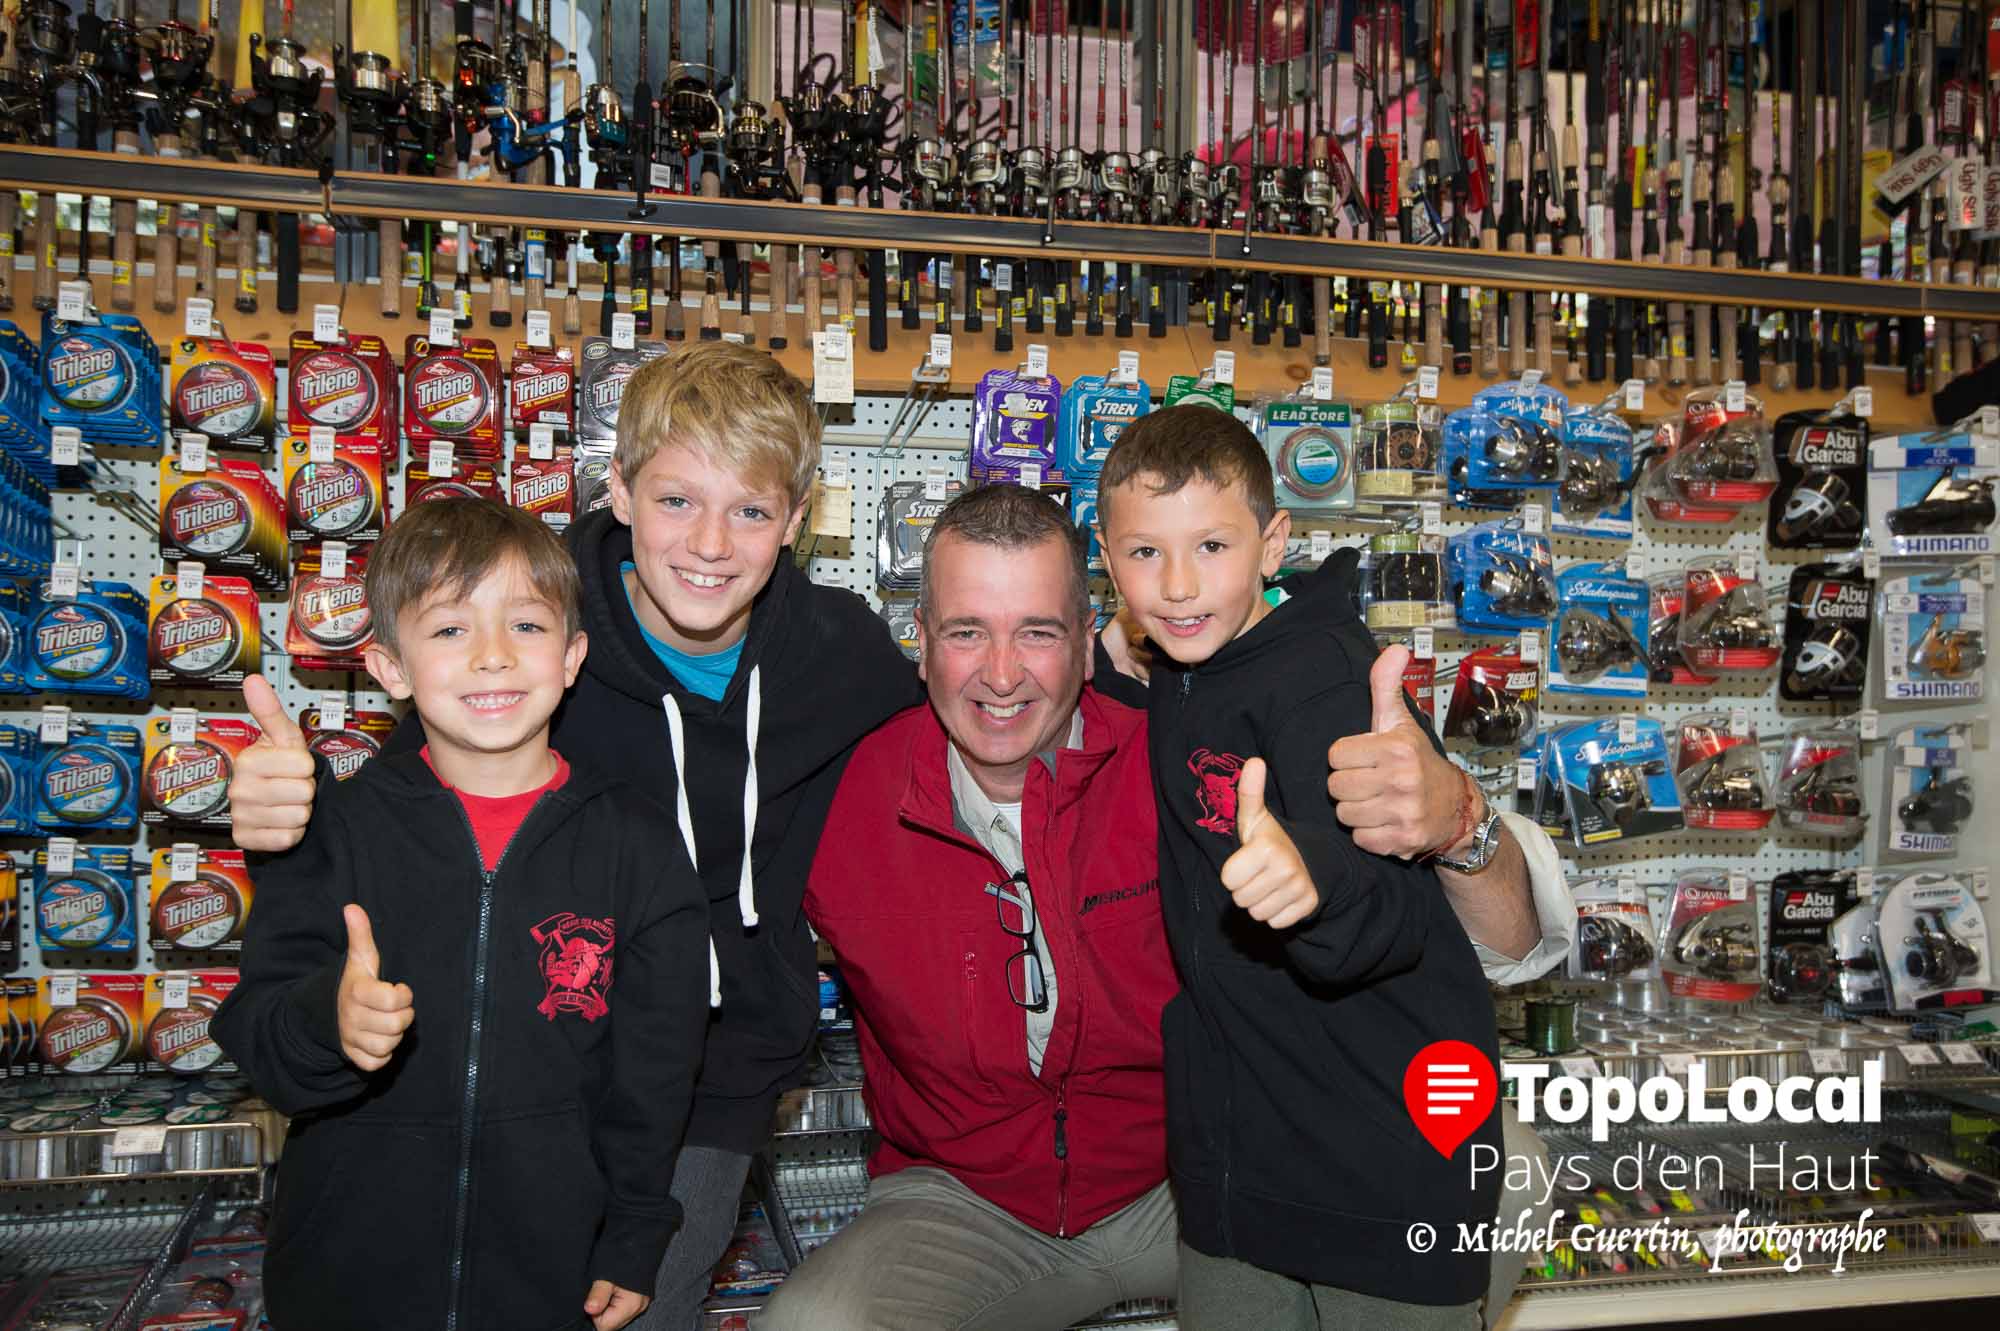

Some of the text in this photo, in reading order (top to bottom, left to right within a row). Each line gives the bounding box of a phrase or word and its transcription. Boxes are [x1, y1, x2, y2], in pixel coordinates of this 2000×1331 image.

[51, 350, 114, 384] Trilene
[186, 381, 244, 412] Trilene
[301, 368, 358, 399] Trilene
[418, 374, 473, 405] Trilene
[515, 373, 568, 403] Trilene
[594, 380, 625, 406] Tril
[999, 393, 1048, 412] SREN
[1091, 399, 1138, 416] STREN
[1272, 411, 1346, 422] LEAD CORE
[1823, 431, 1857, 449] Abu
[585, 464, 605, 473] Ultra
[1803, 448, 1857, 464] Garcia
[298, 476, 356, 509] Trilene
[516, 475, 568, 504] Trilene
[174, 500, 237, 530] Trilene
[904, 501, 947, 518] STRE
[303, 586, 362, 615] Trilene
[1568, 581, 1639, 600] Shakespeare
[1837, 585, 1868, 602] Abu
[1816, 601, 1868, 618] Garcia
[40, 623, 104, 652] Trilene
[162, 618, 222, 648] Trilene
[1505, 671, 1537, 690] ZEBCO
[329, 750, 371, 775] lene
[1575, 740, 1655, 760] Skespeare
[48, 764, 113, 796] Trilene
[157, 757, 218, 791] Trilene
[1901, 834, 1952, 850] SHIMA
[1081, 880, 1158, 914] MERCUR
[1685, 887, 1729, 900] QUANTU
[1802, 891, 1835, 906] Abu
[43, 893, 103, 926] Trilene
[166, 895, 225, 927] Trilene
[1784, 904, 1835, 920] Garcia
[51, 1019, 107, 1053] Trilene
